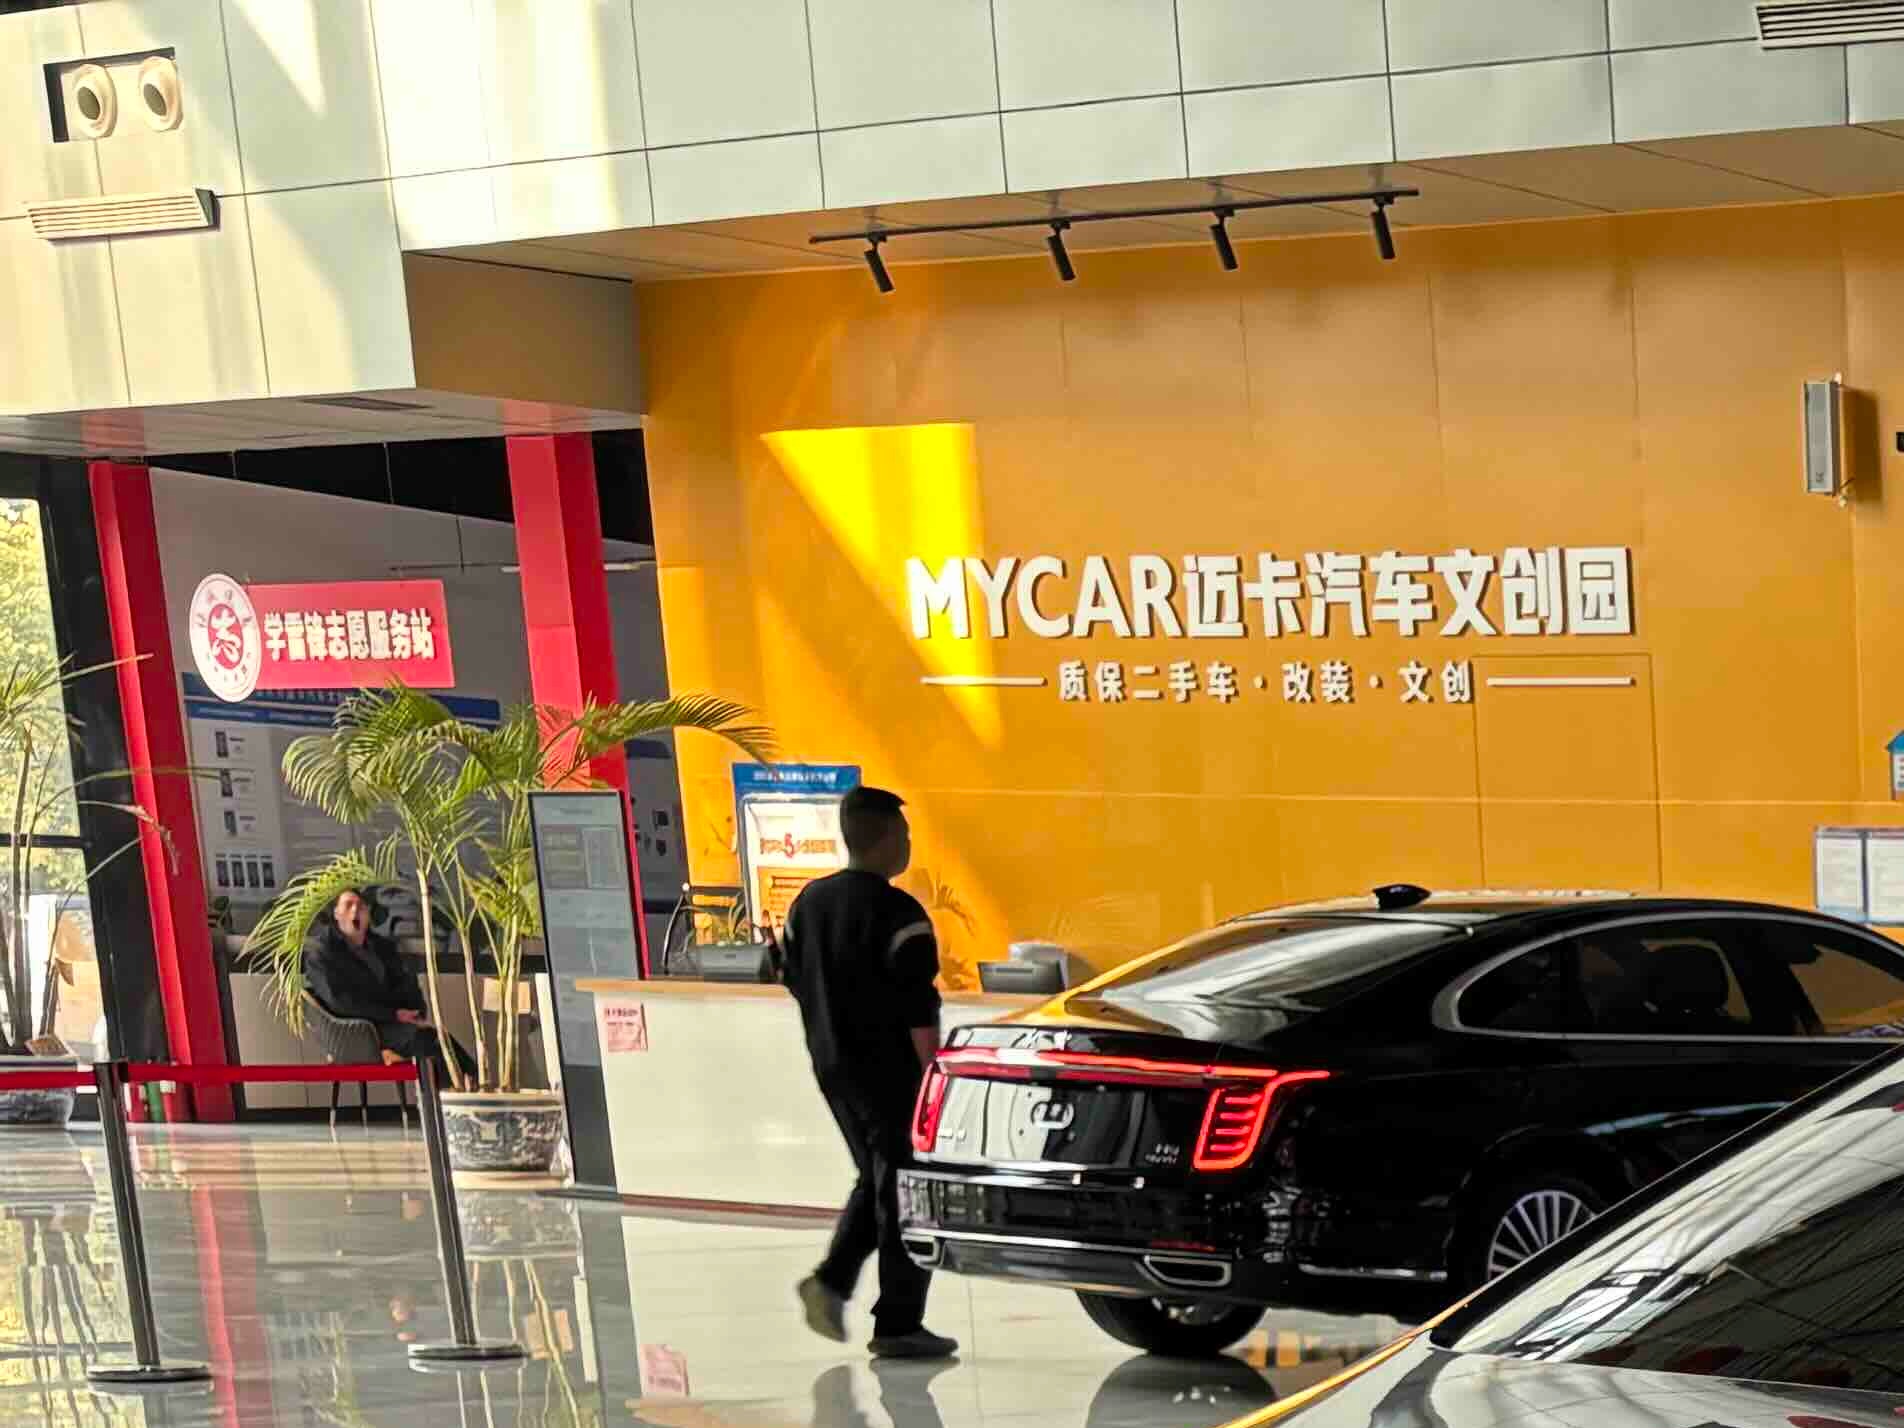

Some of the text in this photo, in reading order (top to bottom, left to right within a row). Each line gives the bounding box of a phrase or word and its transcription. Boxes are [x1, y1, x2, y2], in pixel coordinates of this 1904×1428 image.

[904, 546, 1634, 640] MYCAR迈卡汽车文创园
[263, 607, 436, 662] 学雷锋志愿服务站
